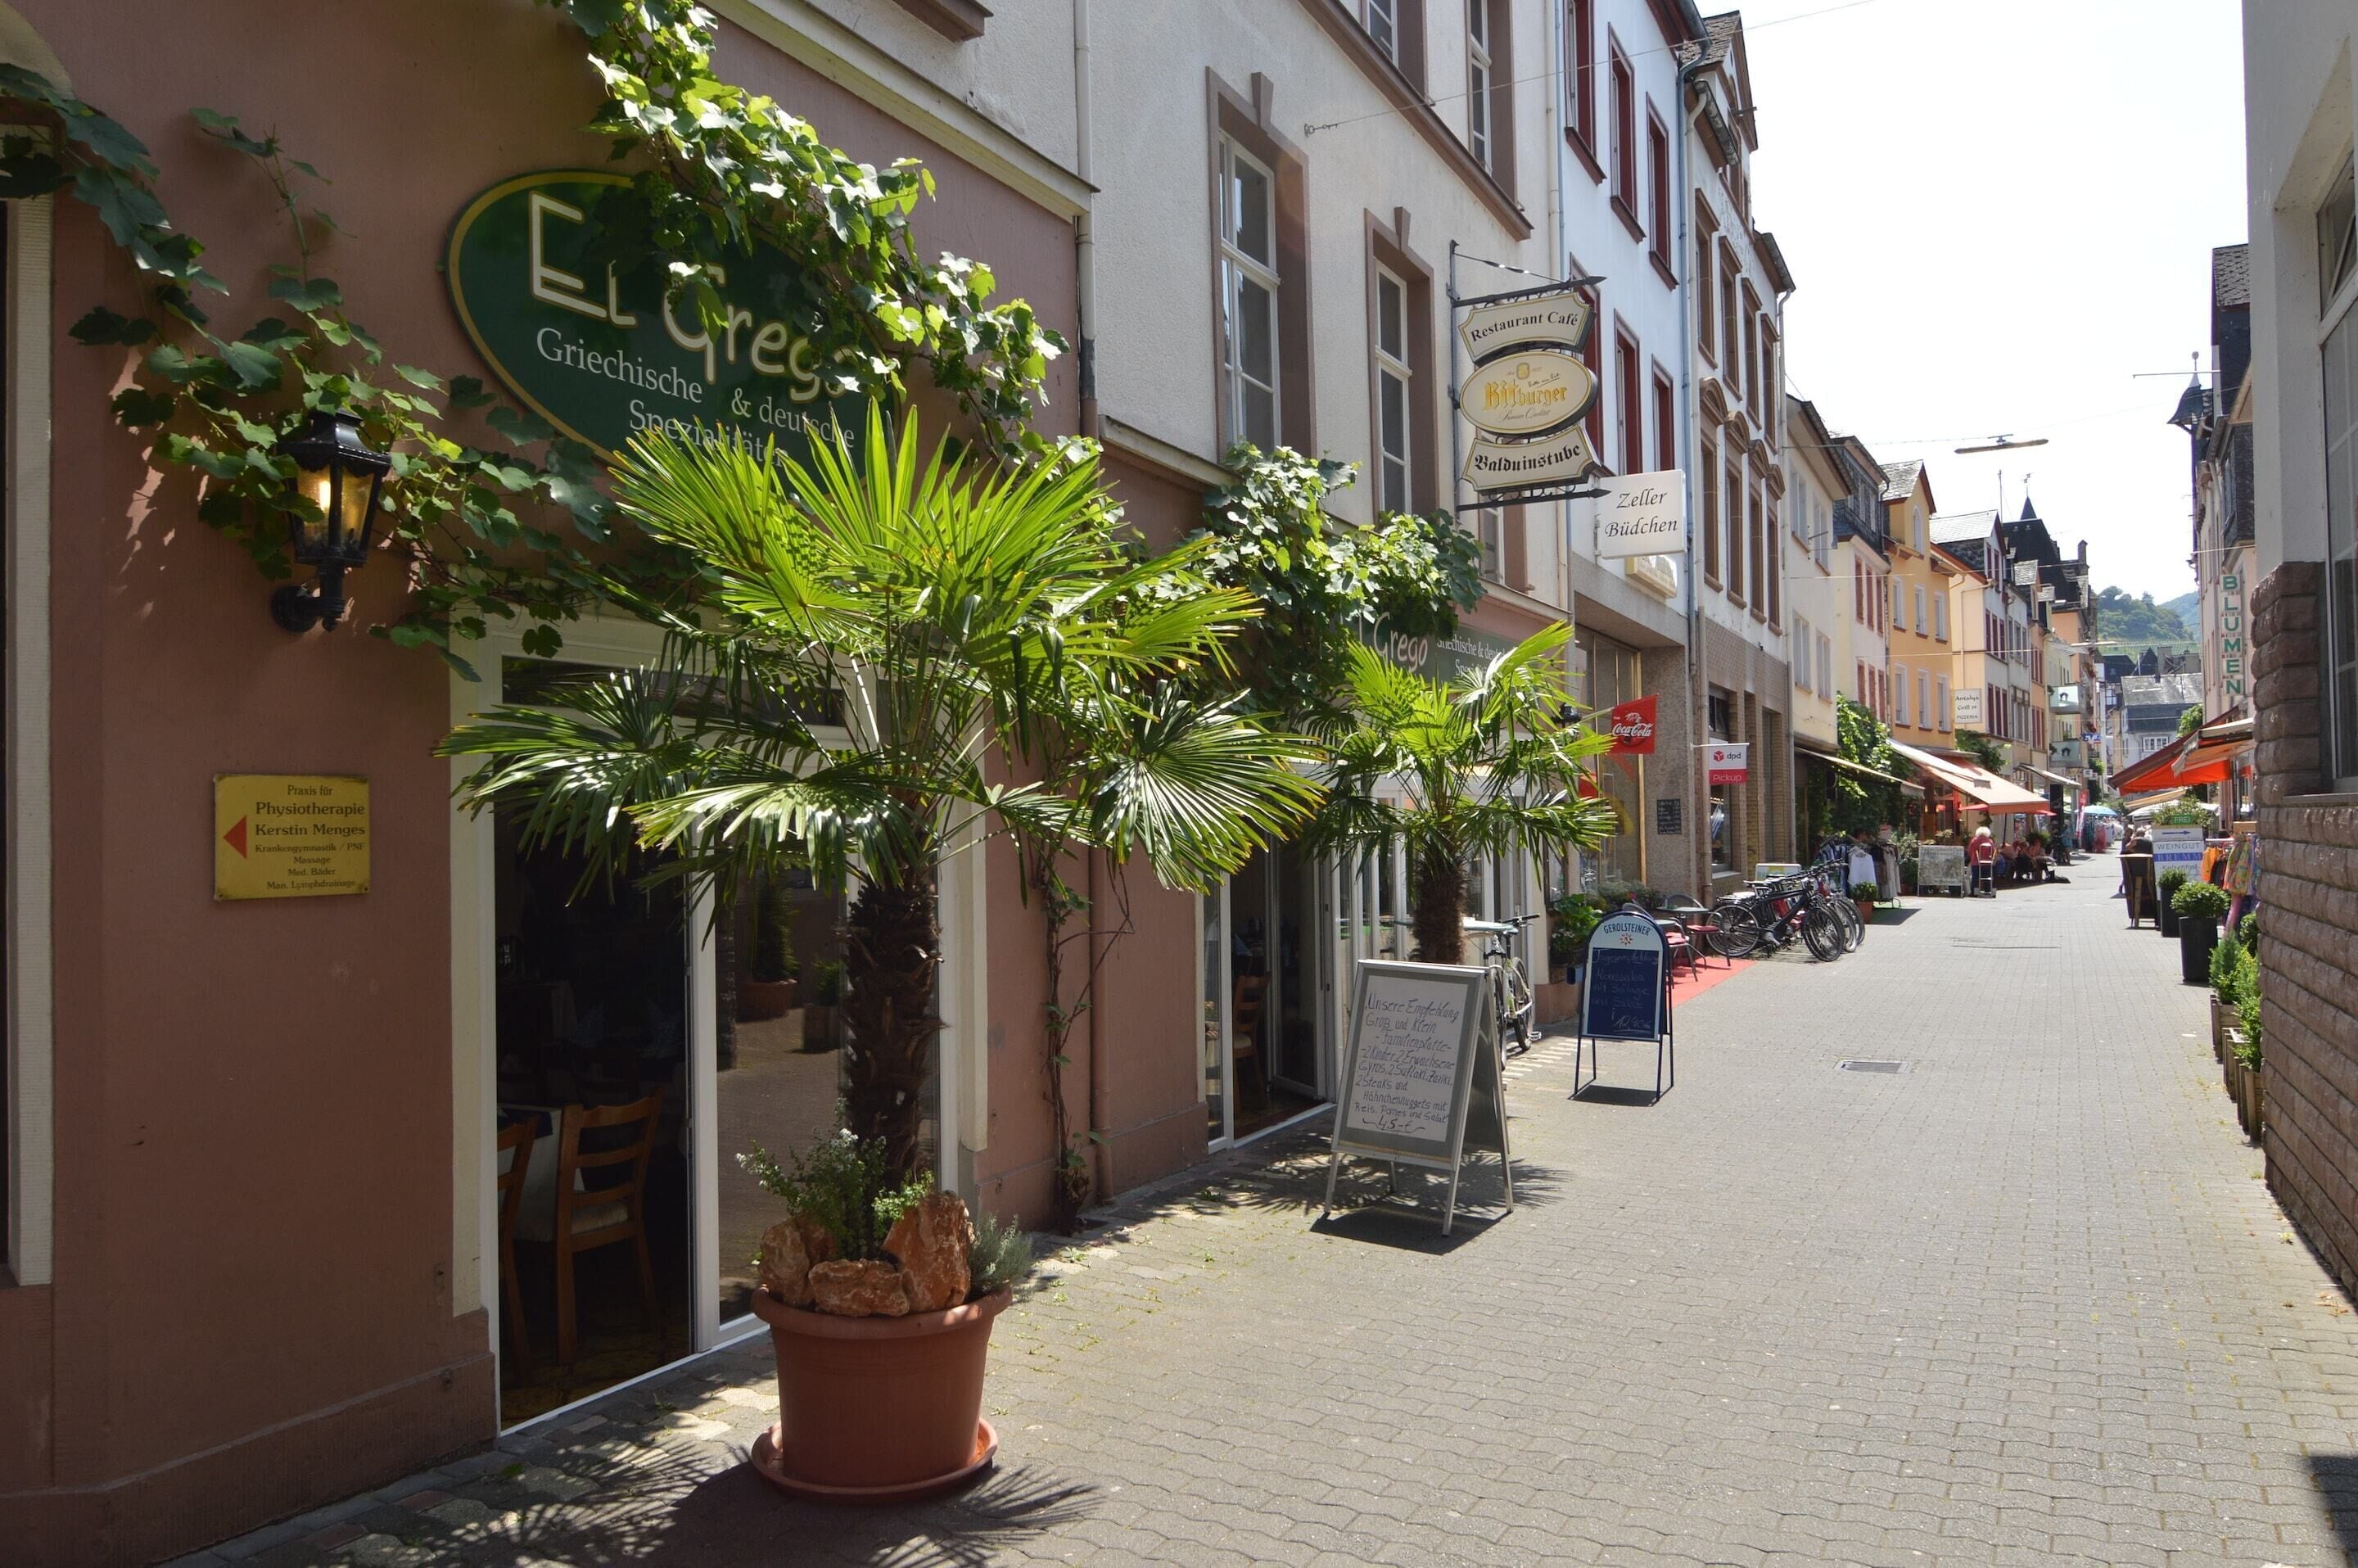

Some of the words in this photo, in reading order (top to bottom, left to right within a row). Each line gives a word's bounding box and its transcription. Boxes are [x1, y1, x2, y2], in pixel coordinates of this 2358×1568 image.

[1470, 313, 1544, 342] Restaurant
[1547, 311, 1578, 327] Café
[536, 328, 703, 403] Griechische
[1483, 378, 1568, 411] Bitburger
[730, 387, 752, 418] &
[1475, 445, 1581, 472] Balduinstube
[1616, 488, 1668, 508] Zeller
[1604, 516, 1678, 537] Büdchen
[2222, 575, 2242, 694] BLUMEN
[1726, 752, 1741, 761] dpd
[1712, 774, 1742, 784] Pickup
[287, 784, 317, 796] Praxis
[319, 784, 333, 796] für
[255, 802, 366, 817] Physiotherapie
[255, 824, 308, 836] Kerstin
[312, 824, 366, 837] Menges
[255, 844, 337, 854] Krankengymnastik
[346, 843, 366, 851] PNF
[293, 856, 331, 865] Massage
[310, 867, 336, 876] Bäder
[267, 882, 288, 890] Man.
[291, 879, 356, 891] Lymphdrainage
[1603, 923, 1651, 936] GEROLSTEINER
[1406, 998, 1459, 1023] Empfehlung
[1394, 1017, 1408, 1030] und
[1412, 1018, 1438, 1033] Klein
[1395, 1080, 1409, 1091] und
[1363, 1091, 1431, 1110] Hähnchennuggets
[1433, 1100, 1448, 1111] mit
